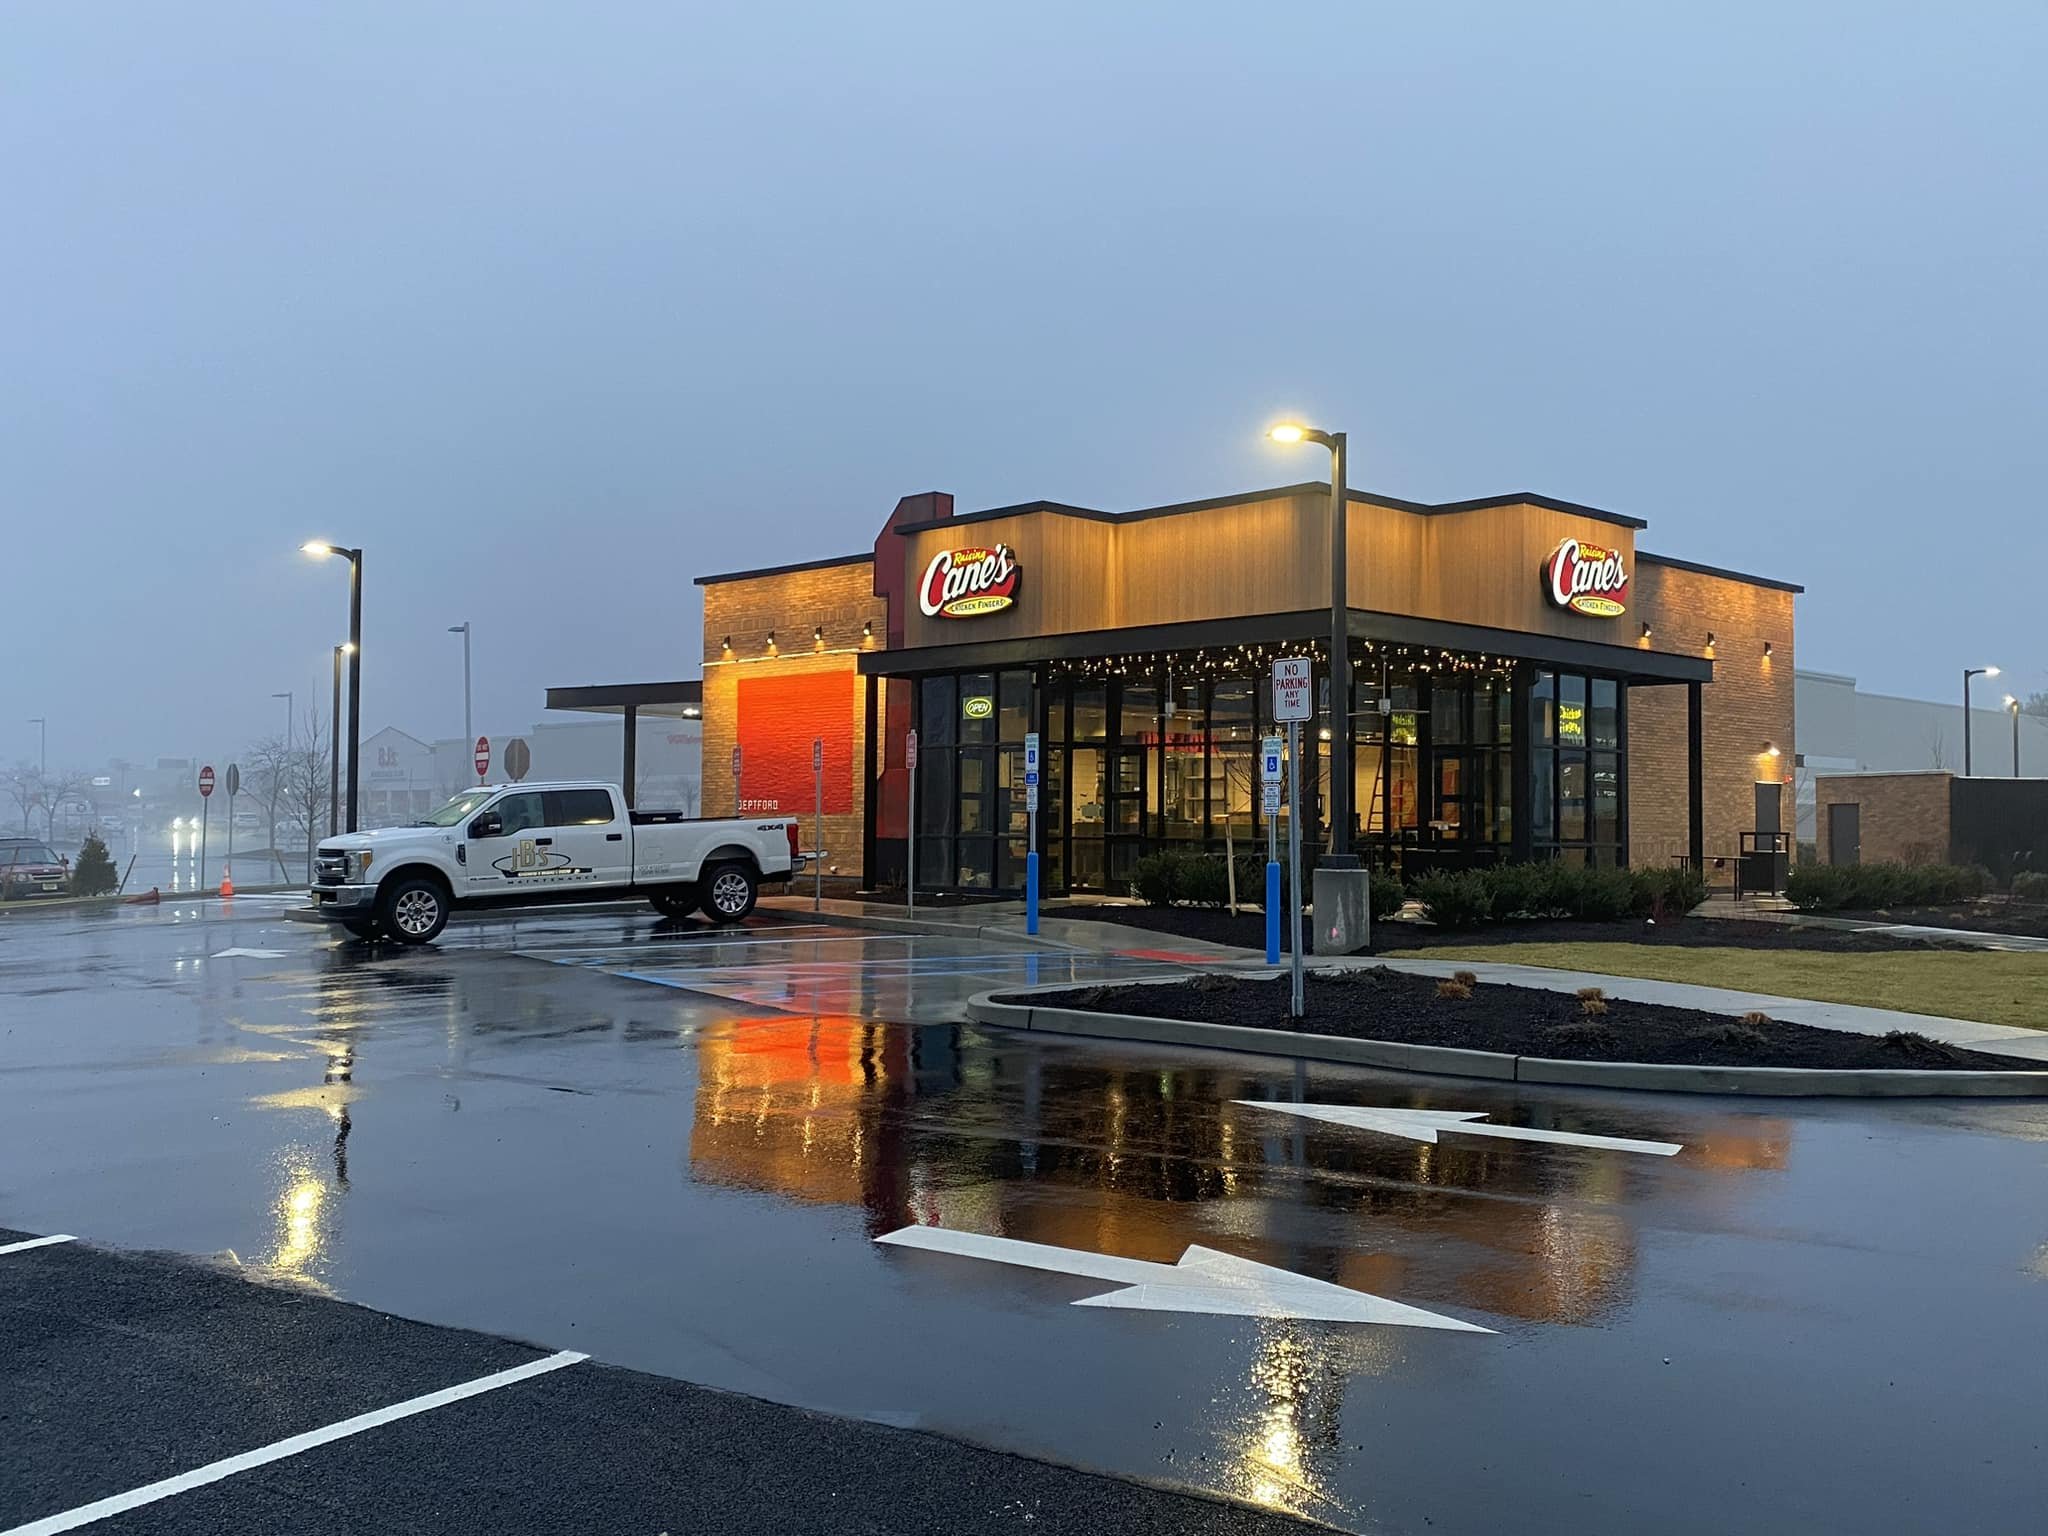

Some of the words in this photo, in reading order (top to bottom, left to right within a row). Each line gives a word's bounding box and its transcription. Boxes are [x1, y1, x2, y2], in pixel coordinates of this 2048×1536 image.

[953, 549, 986, 566] Raising
[1579, 543, 1606, 561] Raising
[1553, 538, 1629, 605] Cane's
[920, 543, 1014, 616] Cane's
[1284, 664, 1298, 676] NO
[1276, 677, 1308, 690] PARKING
[1285, 690, 1300, 699] ANY
[969, 702, 989, 713] OPEN
[1285, 699, 1300, 708] TIME
